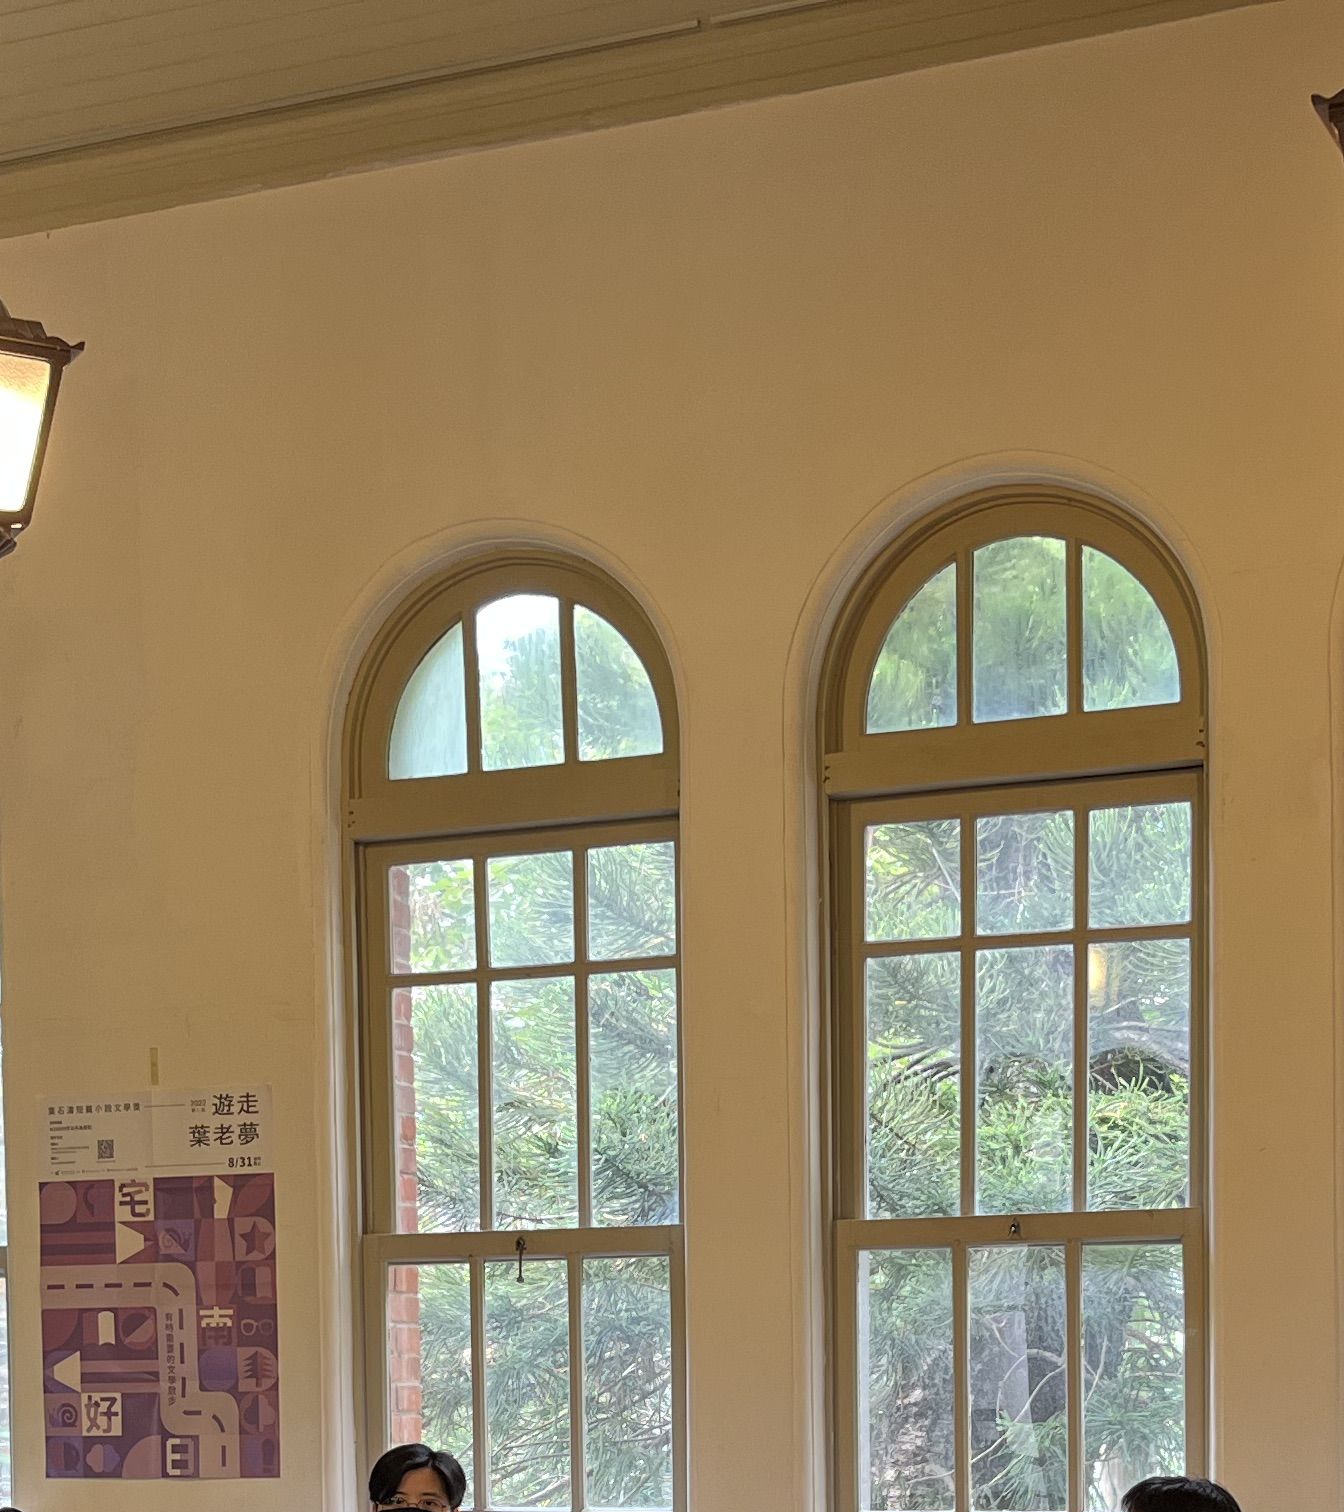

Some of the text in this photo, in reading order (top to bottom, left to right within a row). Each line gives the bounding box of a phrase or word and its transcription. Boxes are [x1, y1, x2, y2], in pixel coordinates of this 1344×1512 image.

[212, 1092, 259, 1115] 遊走
[189, 1122, 259, 1147] 葉老夢
[228, 1157, 252, 1168] 8/31
[118, 1179, 151, 1218] 宅
[85, 1394, 119, 1434] 好
